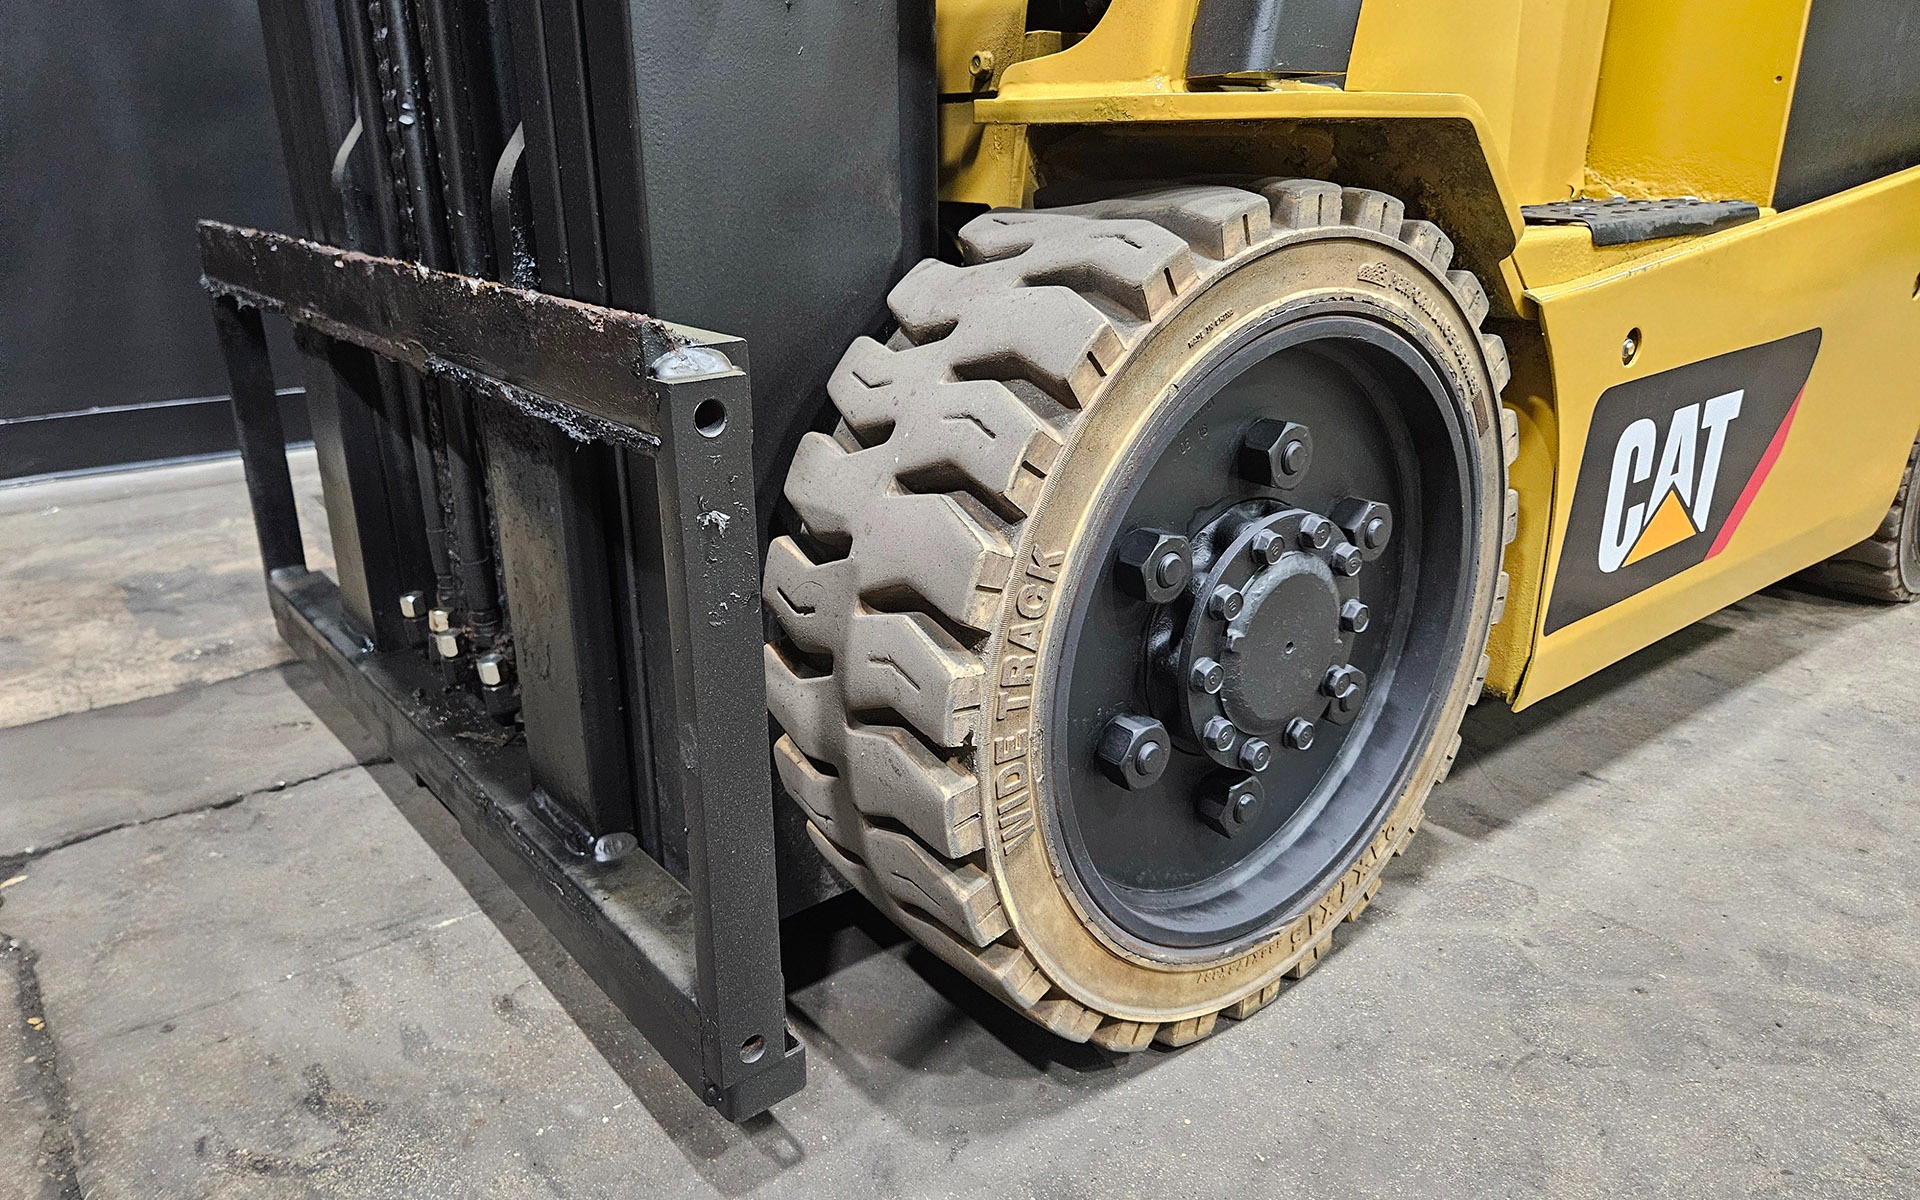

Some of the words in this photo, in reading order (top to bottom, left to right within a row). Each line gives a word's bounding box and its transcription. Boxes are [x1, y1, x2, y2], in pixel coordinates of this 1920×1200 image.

[1598, 389, 1744, 573] CAT
[996, 544, 1065, 721] TRACK
[994, 728, 1036, 856] WIDE
